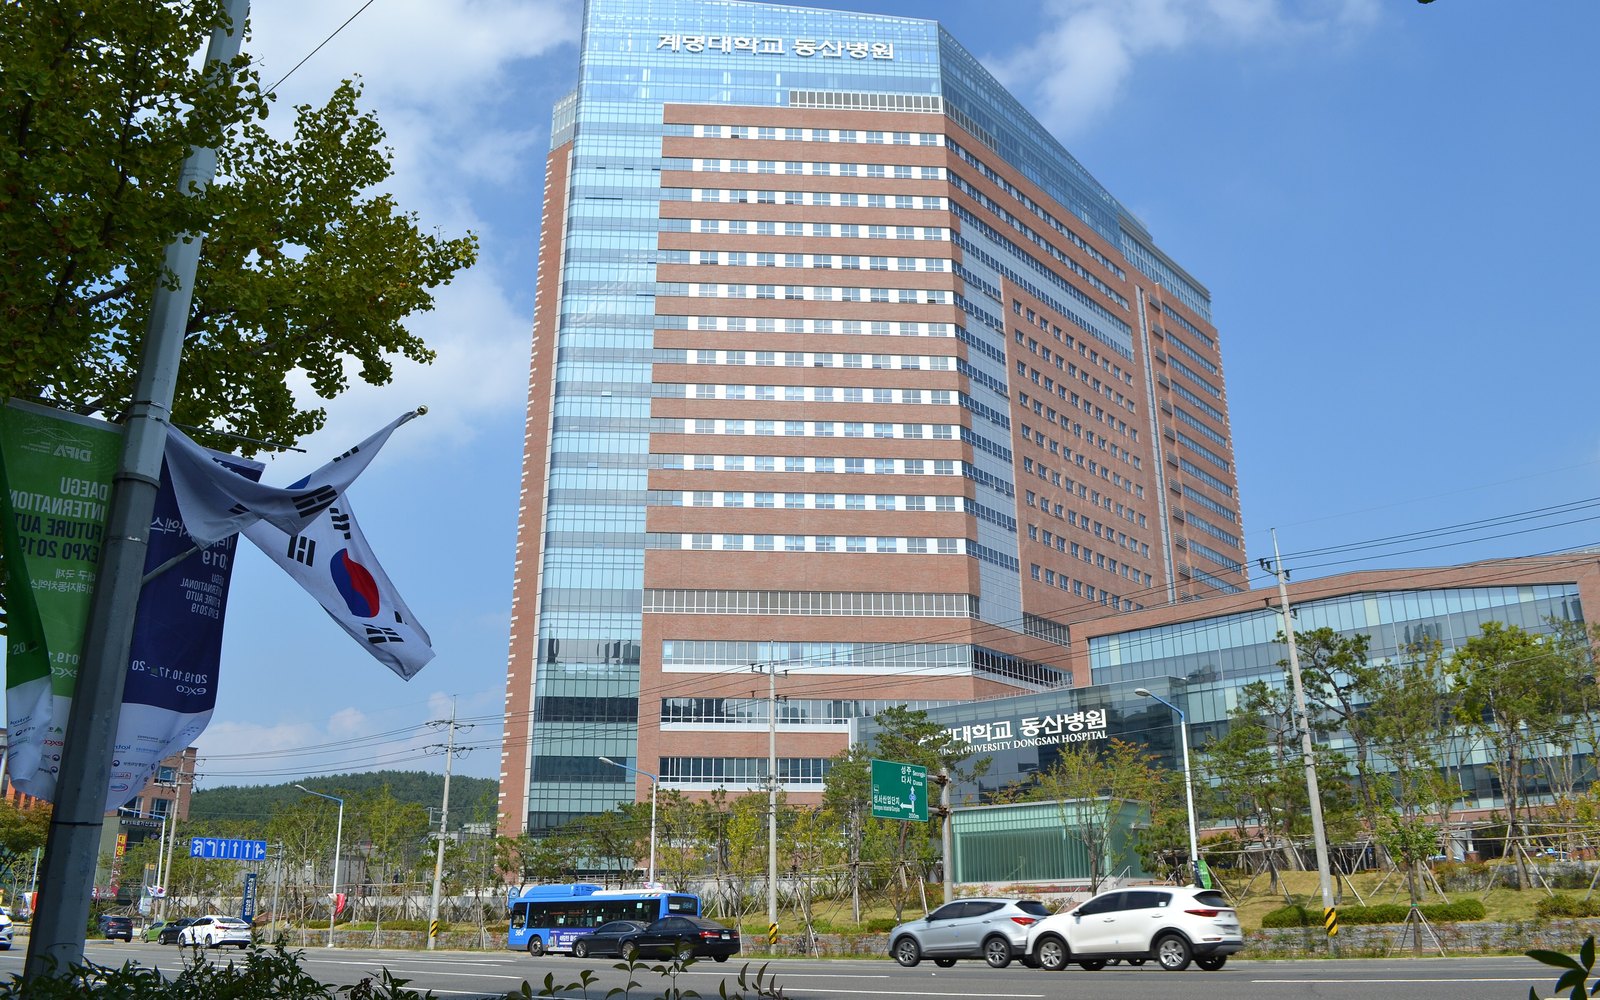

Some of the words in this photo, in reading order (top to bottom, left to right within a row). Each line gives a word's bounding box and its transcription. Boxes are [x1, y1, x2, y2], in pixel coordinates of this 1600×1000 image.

[656, 33, 785, 55] 계명대학교
[792, 38, 894, 60] 동산병원
[918, 720, 1013, 747] 대학교
[1020, 708, 1107, 738] 동산병원
[1013, 735, 1059, 749] DONGSAN
[1061, 730, 1108, 744] HOSPITAL
